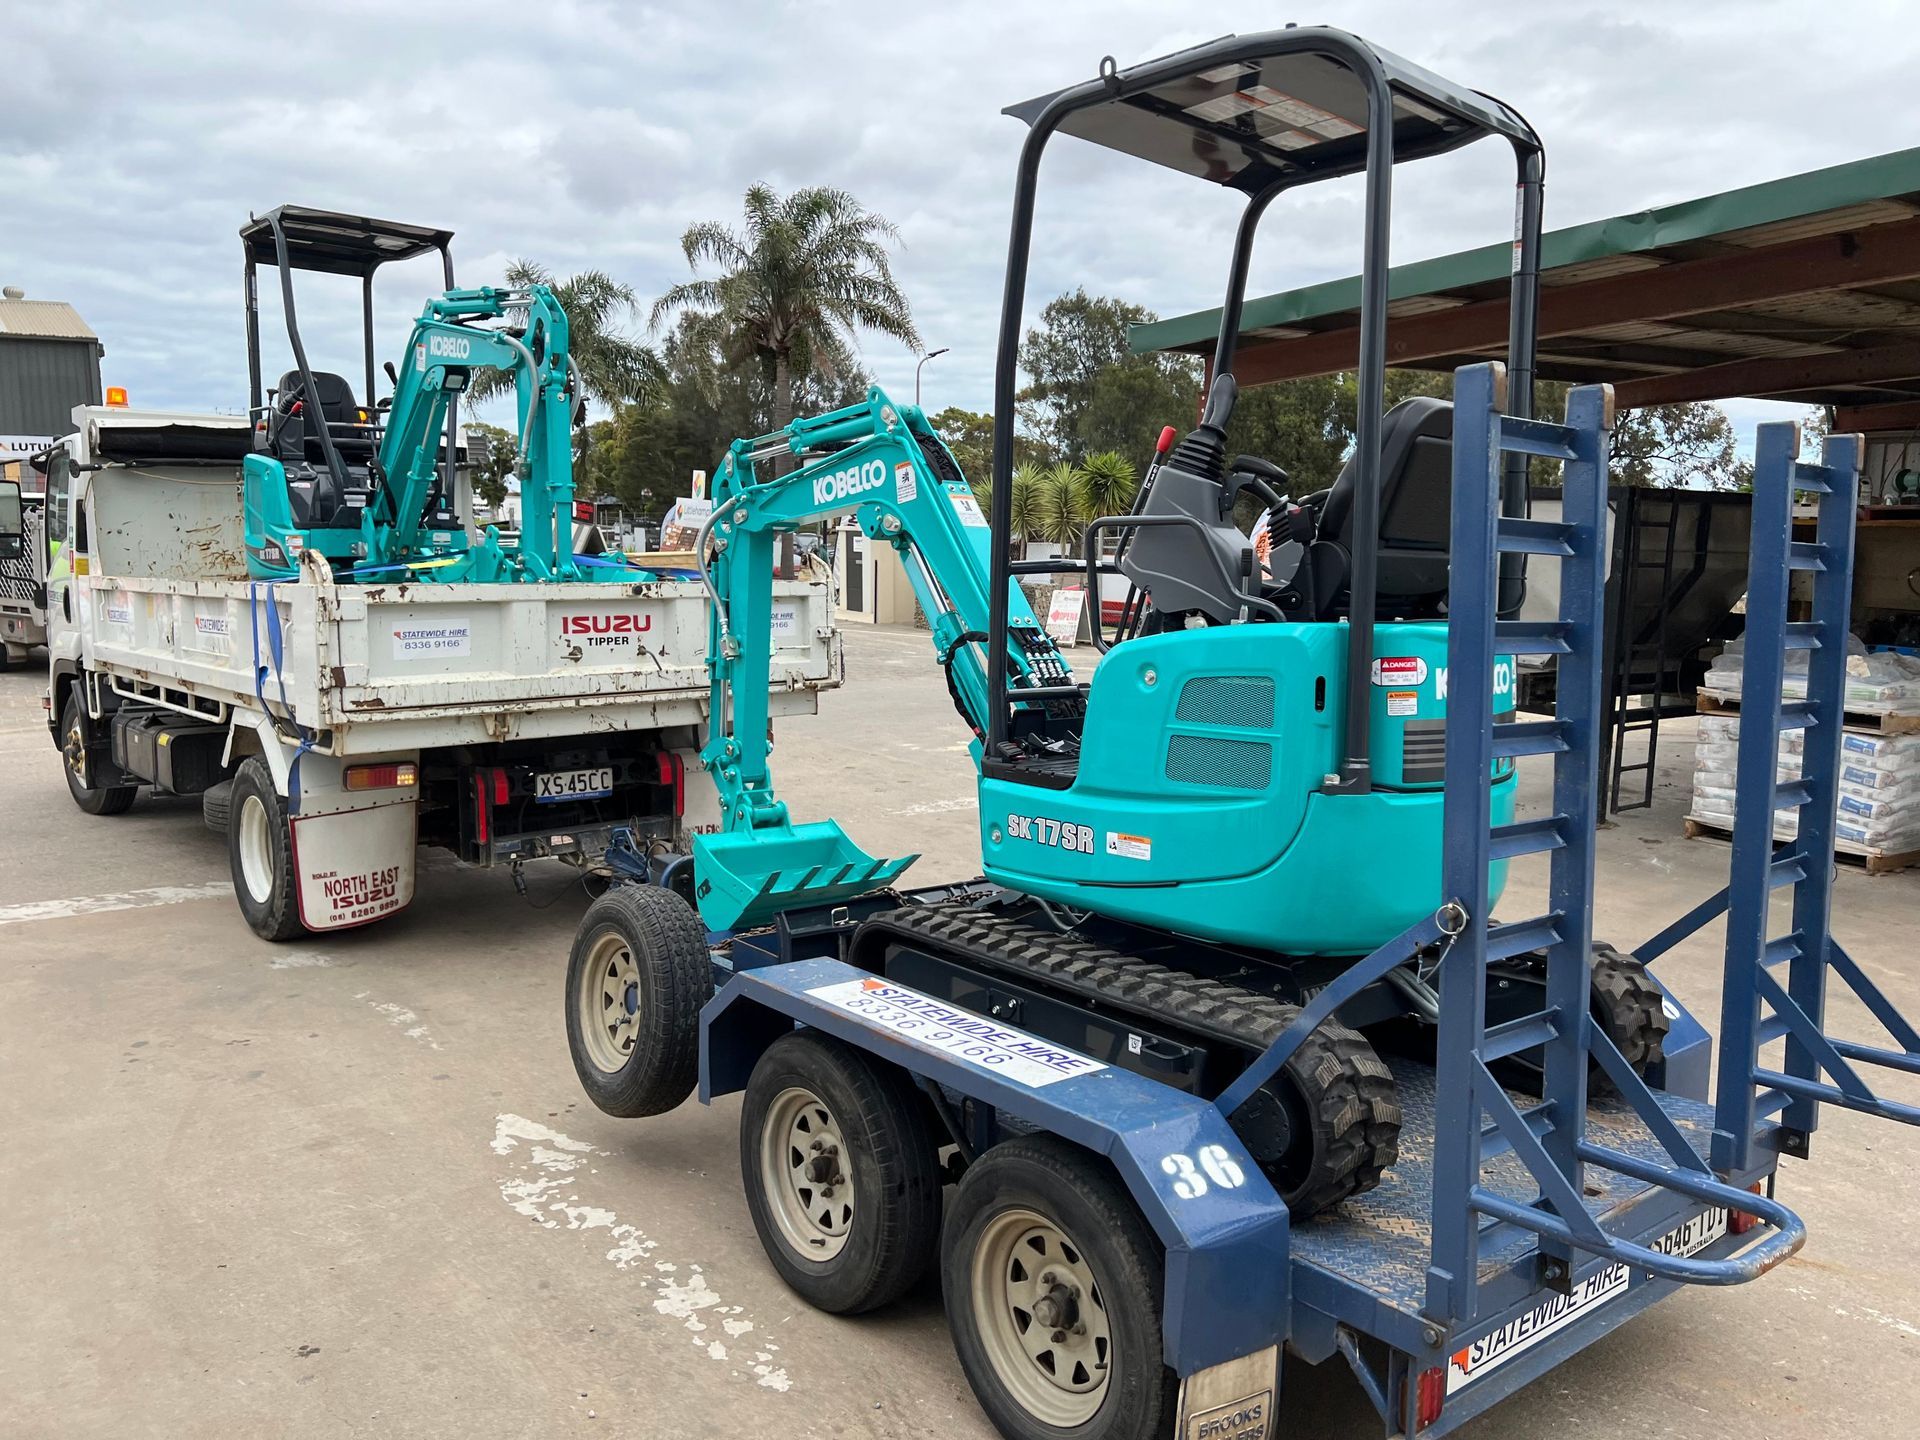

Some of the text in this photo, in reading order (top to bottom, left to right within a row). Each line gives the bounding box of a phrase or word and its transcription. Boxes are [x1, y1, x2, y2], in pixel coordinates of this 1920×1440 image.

[430, 335, 470, 359] KOBELCO
[812, 459, 887, 506] KOBELCO
[402, 628, 468, 639] STATEWIDE HIRE
[562, 614, 651, 634] ISUZU
[404, 639, 460, 649] 8336 9166
[587, 636, 629, 646] TIPPER
[324, 866, 399, 897] NORTH EAST
[332, 884, 395, 910] ISUZU
[846, 998, 1013, 1065] 8336 9166
[871, 987, 1017, 1043] STATEWIDE
[1011, 1042, 1091, 1071] HIRE
[1161, 1144, 1245, 1199] 36
[1585, 1262, 1626, 1299] HIRE
[1471, 1291, 1578, 1364] STATEWIDE
[1198, 1403, 1262, 1439] BROOKS
